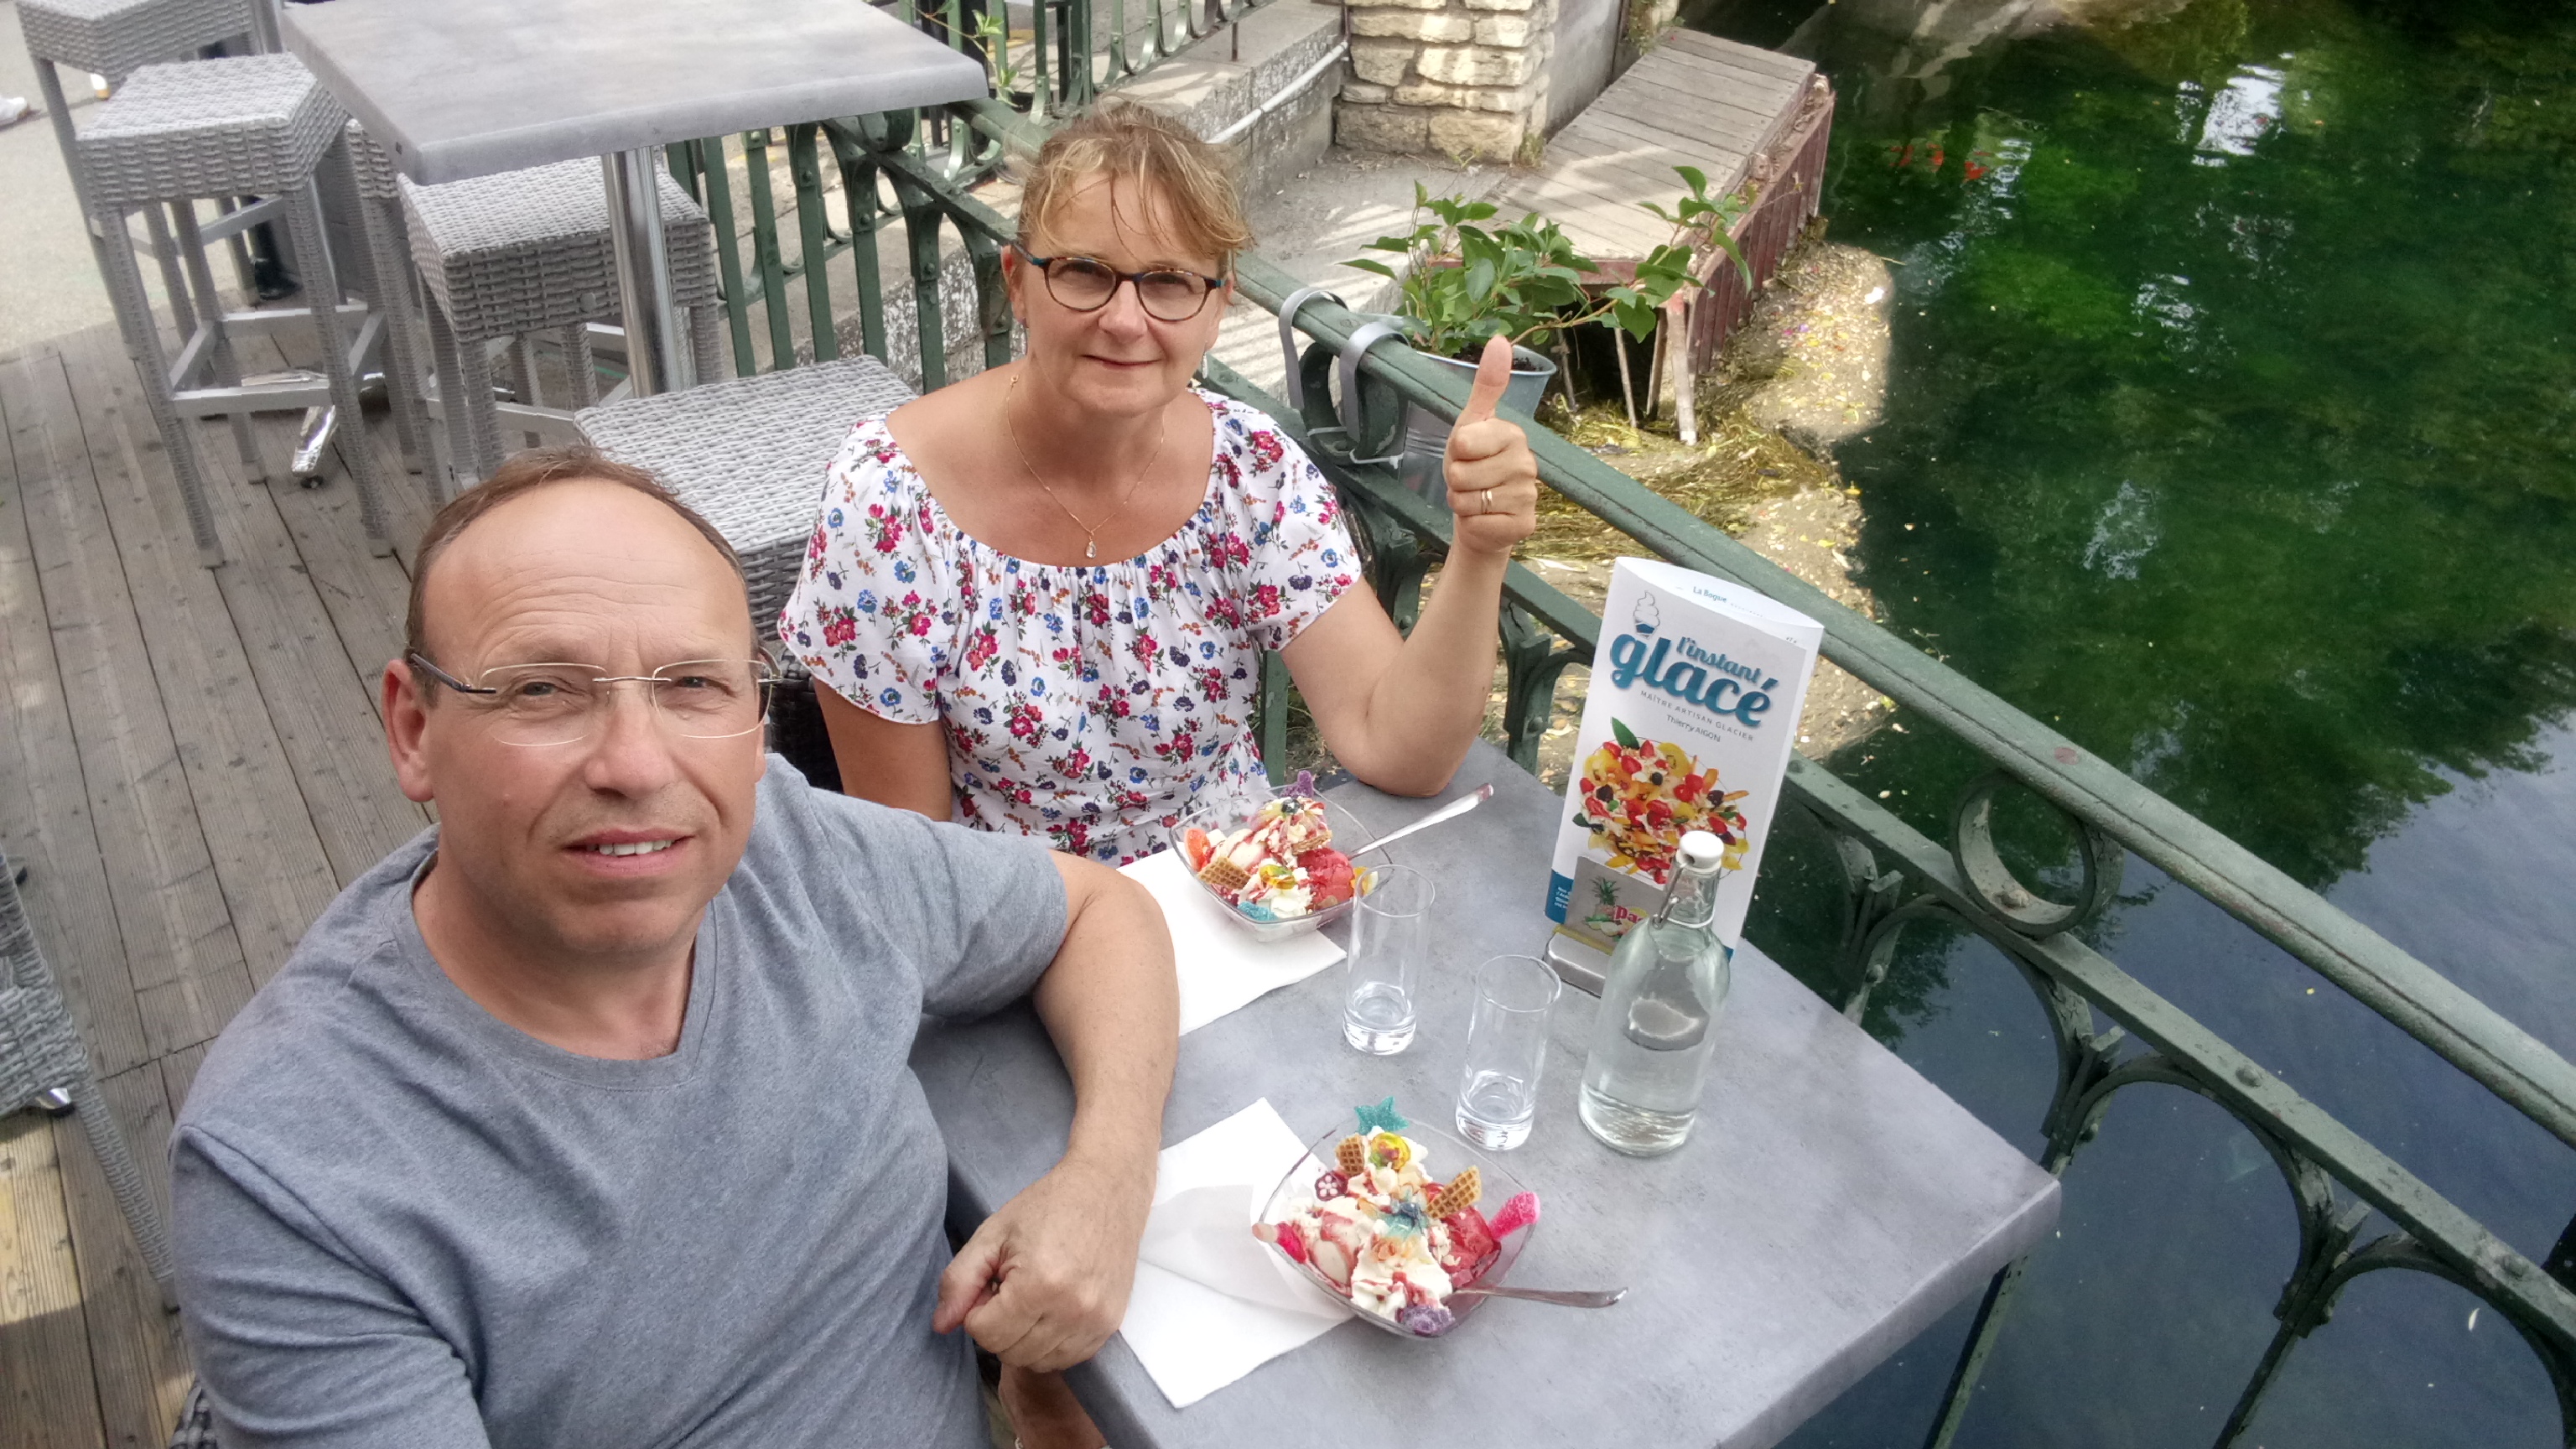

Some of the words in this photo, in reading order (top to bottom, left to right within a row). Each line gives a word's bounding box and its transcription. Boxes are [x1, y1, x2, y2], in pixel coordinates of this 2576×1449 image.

[1693, 586, 1702, 595] La
[1610, 633, 1779, 727] glacé
[1666, 714, 1695, 732] Thierry
[1695, 726, 1722, 743] AIGON
[1675, 705, 1712, 725] ARTISAN
[1715, 721, 1754, 742] GLACIER
